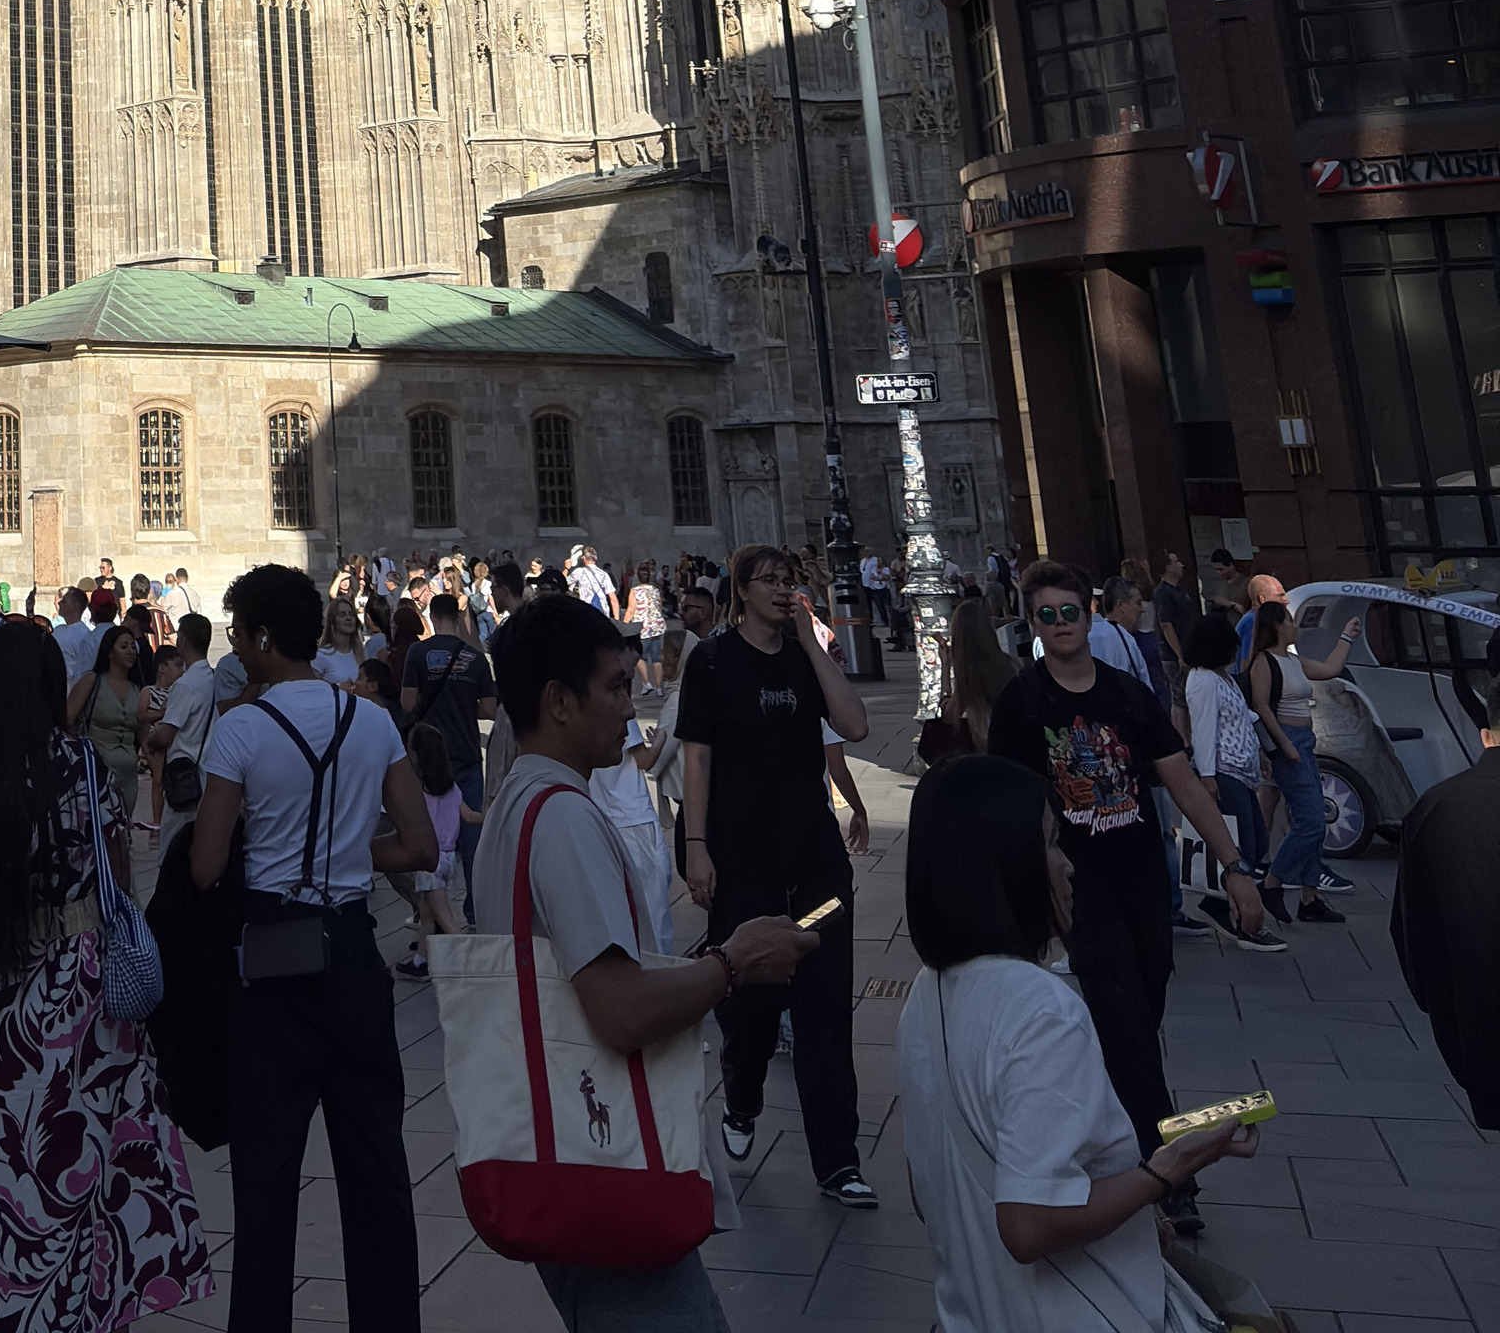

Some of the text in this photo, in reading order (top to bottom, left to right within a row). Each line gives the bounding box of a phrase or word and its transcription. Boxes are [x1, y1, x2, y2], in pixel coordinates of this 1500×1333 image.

[1346, 155, 1422, 186] Bank
[1341, 584, 1366, 594] ON
[1370, 587, 1391, 598] MY
[1397, 592, 1430, 607] WAY
[1435, 599, 1457, 613] TO
